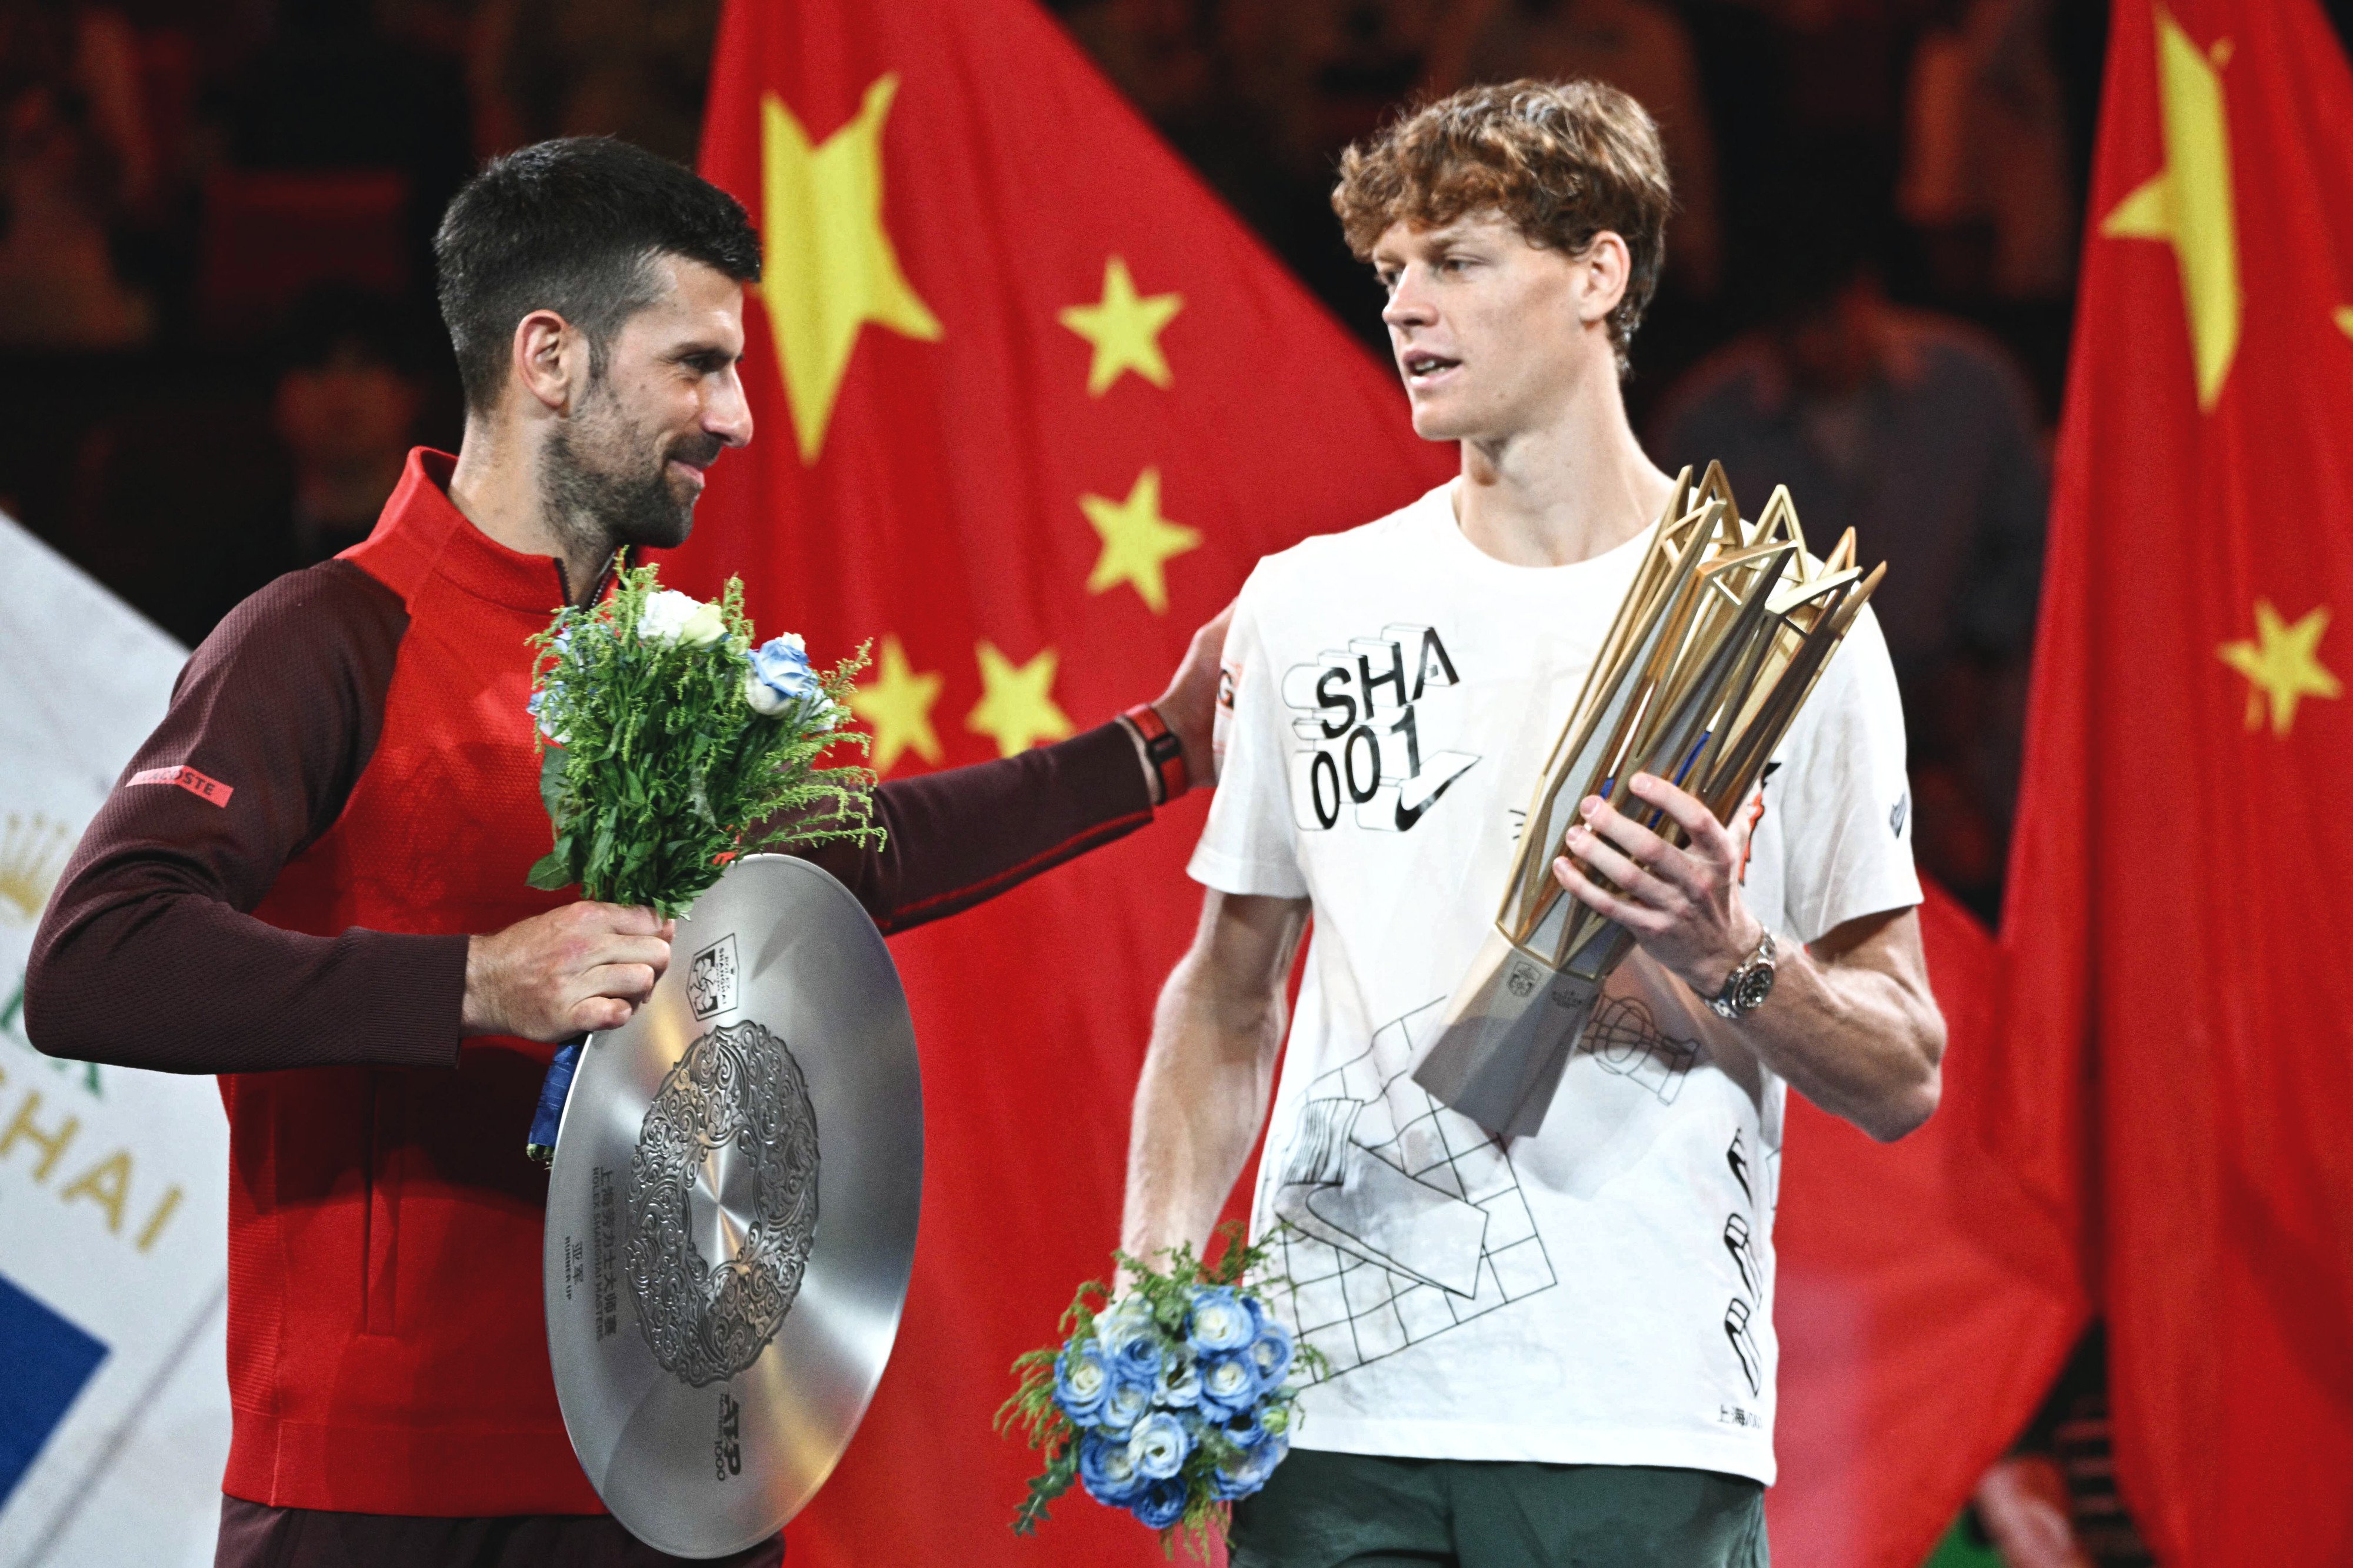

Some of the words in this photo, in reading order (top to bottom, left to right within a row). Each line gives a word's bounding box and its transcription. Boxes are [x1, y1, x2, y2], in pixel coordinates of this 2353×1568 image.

[1316, 627, 1460, 739] SHA
[1311, 703, 1421, 830] 001
[0, 1066, 183, 1253] HAI
[564, 1236, 572, 1283] RUNNER
[572, 1241, 584, 1285] 亚军
[594, 1213, 602, 1277] SHANGHAI
[600, 1166, 618, 1336] 上海劳力士大师赛
[565, 1285, 572, 1300] UP
[595, 1282, 604, 1342] MASTERS
[714, 1439, 726, 1482] 1000
[723, 1394, 741, 1476] ATP
